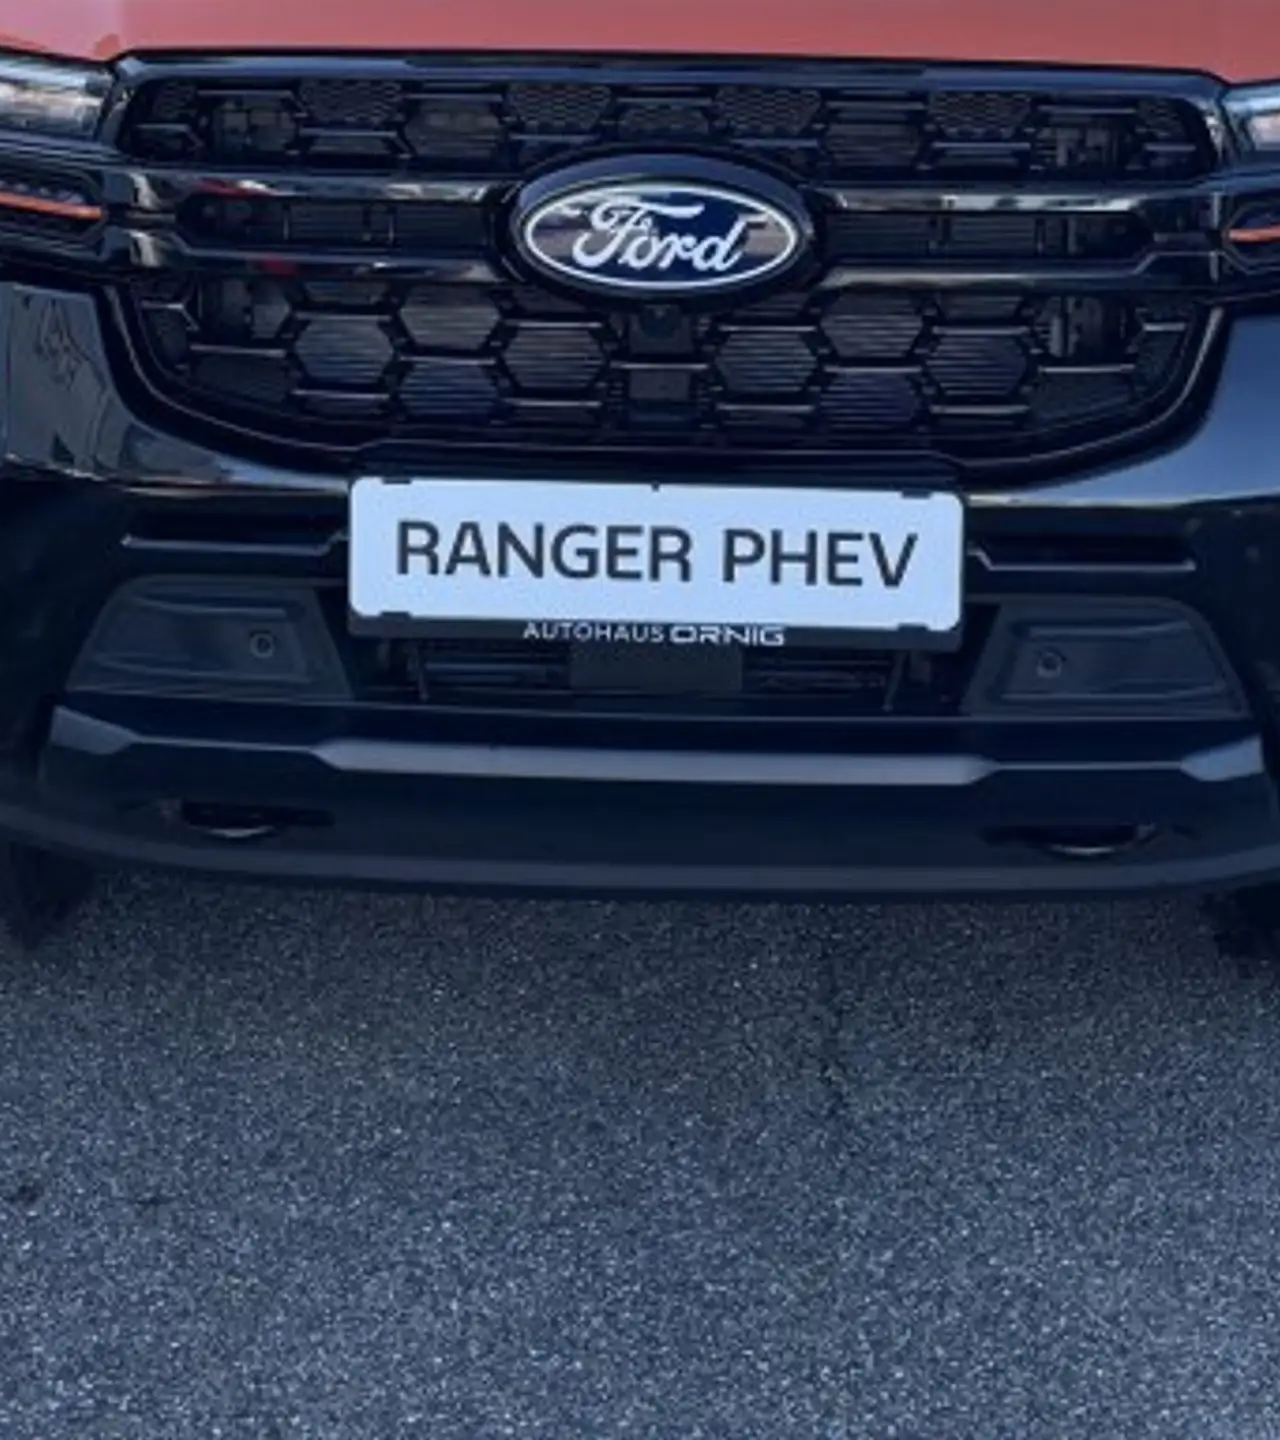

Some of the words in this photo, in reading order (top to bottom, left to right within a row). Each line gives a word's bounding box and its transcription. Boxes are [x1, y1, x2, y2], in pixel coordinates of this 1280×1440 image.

[572, 197, 749, 272] Ford
[397, 520, 692, 582] RANGER
[723, 528, 918, 588] PHEV
[523, 621, 664, 643] AUTOHAUS
[670, 624, 785, 646] ORNIG
